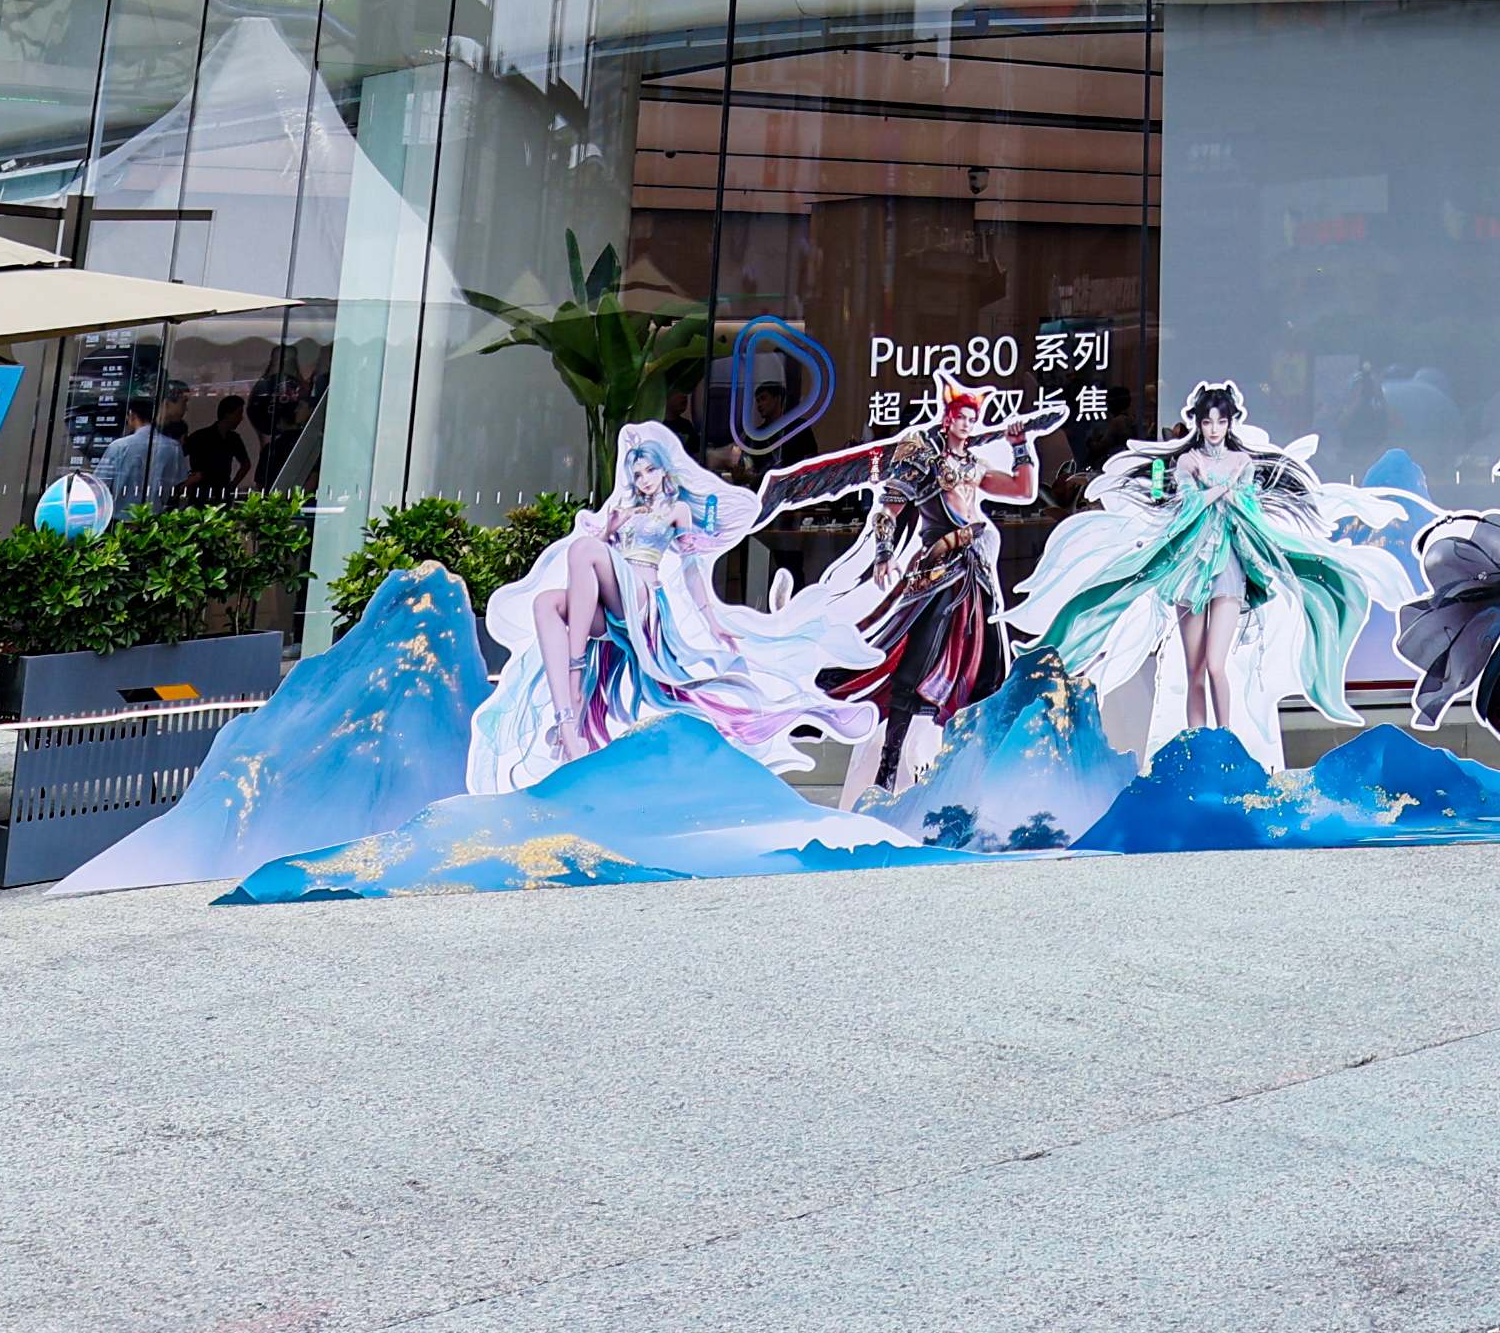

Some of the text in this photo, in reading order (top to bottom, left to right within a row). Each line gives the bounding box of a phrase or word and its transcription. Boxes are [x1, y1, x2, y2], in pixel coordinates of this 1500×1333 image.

[870, 331, 1109, 377] Pura80 系列
[868, 387, 1108, 427] 超大双长焦
